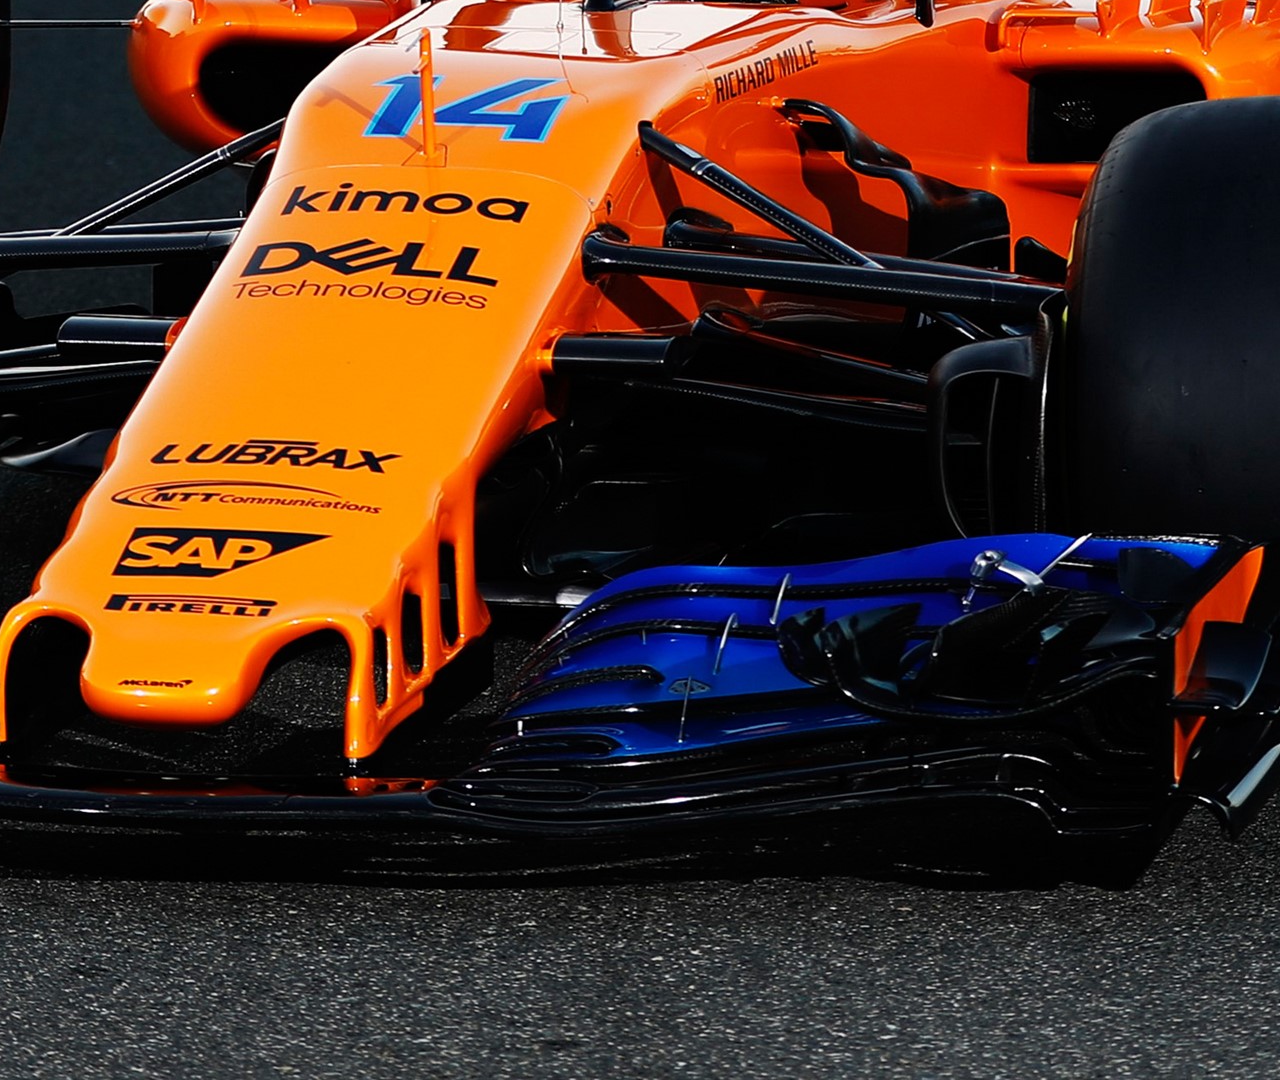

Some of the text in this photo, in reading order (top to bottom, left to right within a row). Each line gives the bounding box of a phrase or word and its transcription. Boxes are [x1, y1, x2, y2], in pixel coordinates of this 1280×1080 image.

[713, 39, 819, 105] RICHARD MILLE
[361, 73, 572, 143] 14
[280, 182, 530, 224] kimoa
[240, 238, 498, 288] DELL
[232, 279, 488, 309] Technologies
[150, 439, 402, 474] LUBRAX
[151, 491, 382, 514] NTT Communications
[120, 535, 273, 570] SAP
[104, 593, 278, 617] PIRELLI
[118, 679, 184, 689] McLaren
